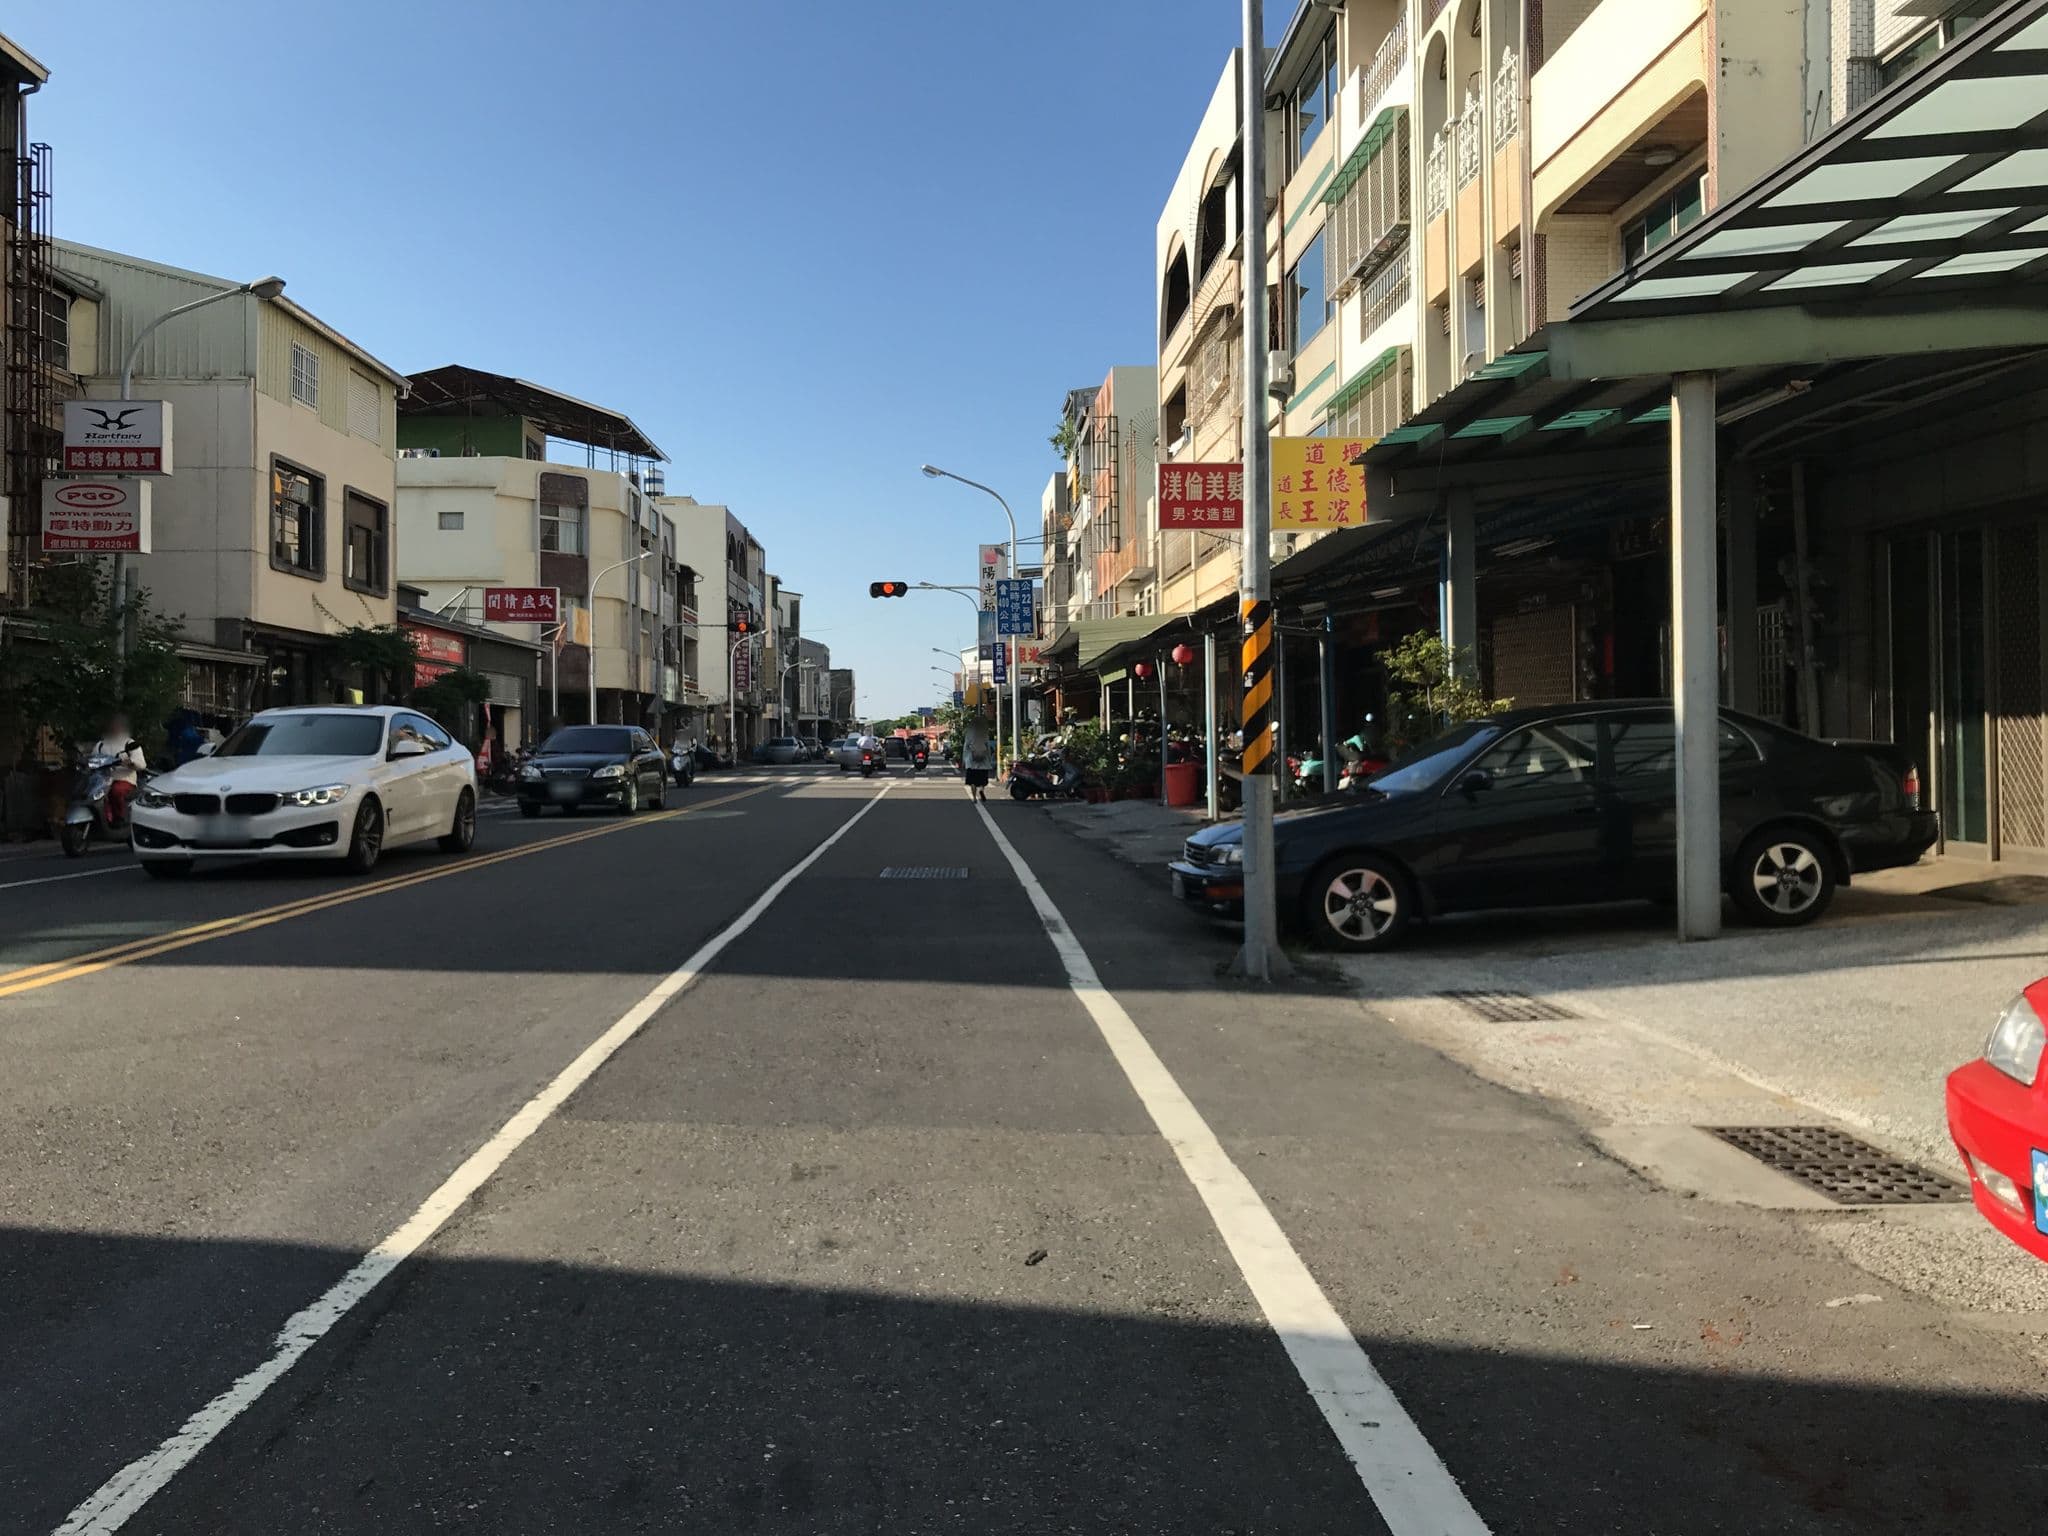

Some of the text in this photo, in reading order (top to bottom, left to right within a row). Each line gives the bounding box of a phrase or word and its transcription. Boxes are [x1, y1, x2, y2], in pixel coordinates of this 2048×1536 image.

[67, 492, 115, 500] PGO
[49, 519, 133, 531] 摩特動力
